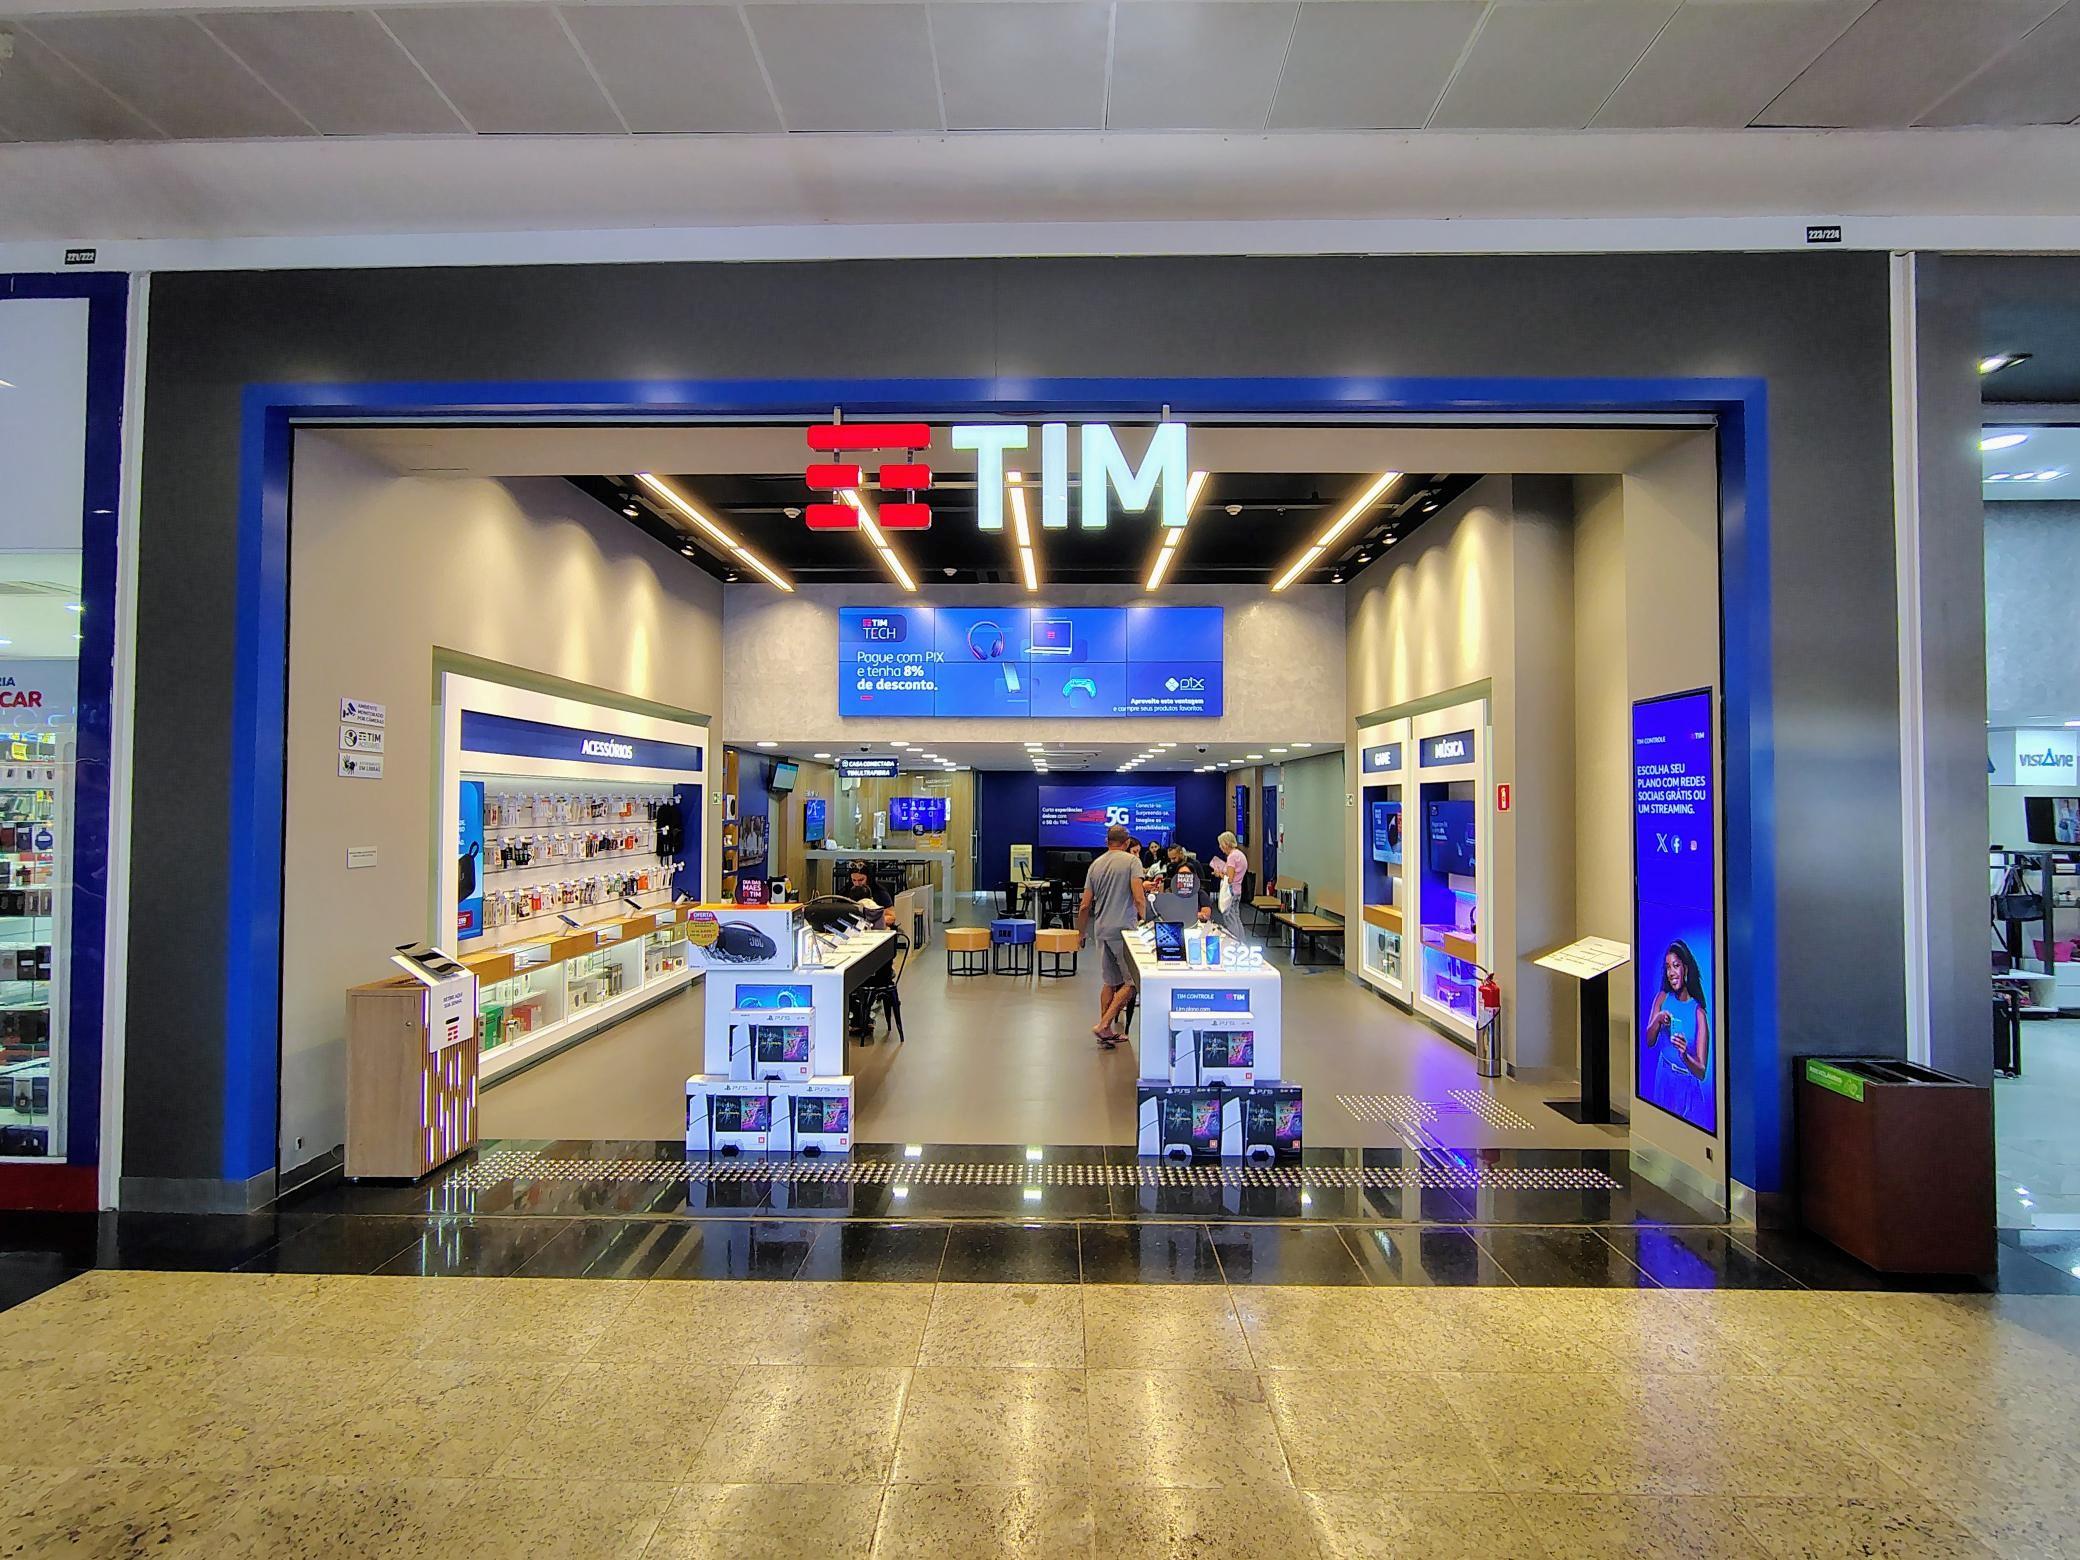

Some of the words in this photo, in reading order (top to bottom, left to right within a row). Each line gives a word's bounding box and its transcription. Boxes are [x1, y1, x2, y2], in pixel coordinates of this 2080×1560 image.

[951, 422, 1189, 531] TIM
[872, 618, 888, 627] TIM
[863, 627, 896, 639] TECH
[857, 651, 894, 667] Pague
[896, 653, 923, 663] com
[925, 651, 945, 663] PIX
[857, 667, 865, 677] e
[866, 665, 901, 677] tenha
[903, 665, 925, 677] 8%
[0, 677, 16, 686] IA
[857, 678, 873, 691] de
[875, 678, 939, 691] desconto.
[1180, 677, 1205, 691] pix
[1154, 705, 1179, 713] produtos
[368, 732, 382, 743] TIM
[1644, 736, 1666, 744] CONTROLE
[1695, 732, 1705, 740] TIM
[581, 738, 633, 759] ACESSÓRIOS
[1434, 739, 1465, 759] MÚSICA
[1637, 765, 1669, 776] ESCOLHA
[1670, 763, 1686, 774] SEU
[1637, 777, 1662, 788] PLANO
[1662, 777, 1680, 788] COM
[1681, 776, 1706, 787] REDES
[1638, 790, 1665, 801] SOCIAIS
[1666, 787, 1693, 801] GRÁTIS
[1693, 789, 1706, 800] OU
[1638, 804, 1650, 814] UM
[1650, 803, 1696, 815] STREAMING.
[1104, 806, 1129, 827] 5G
[1222, 945, 1264, 967] S25
[1233, 993, 1246, 1001] TIM
